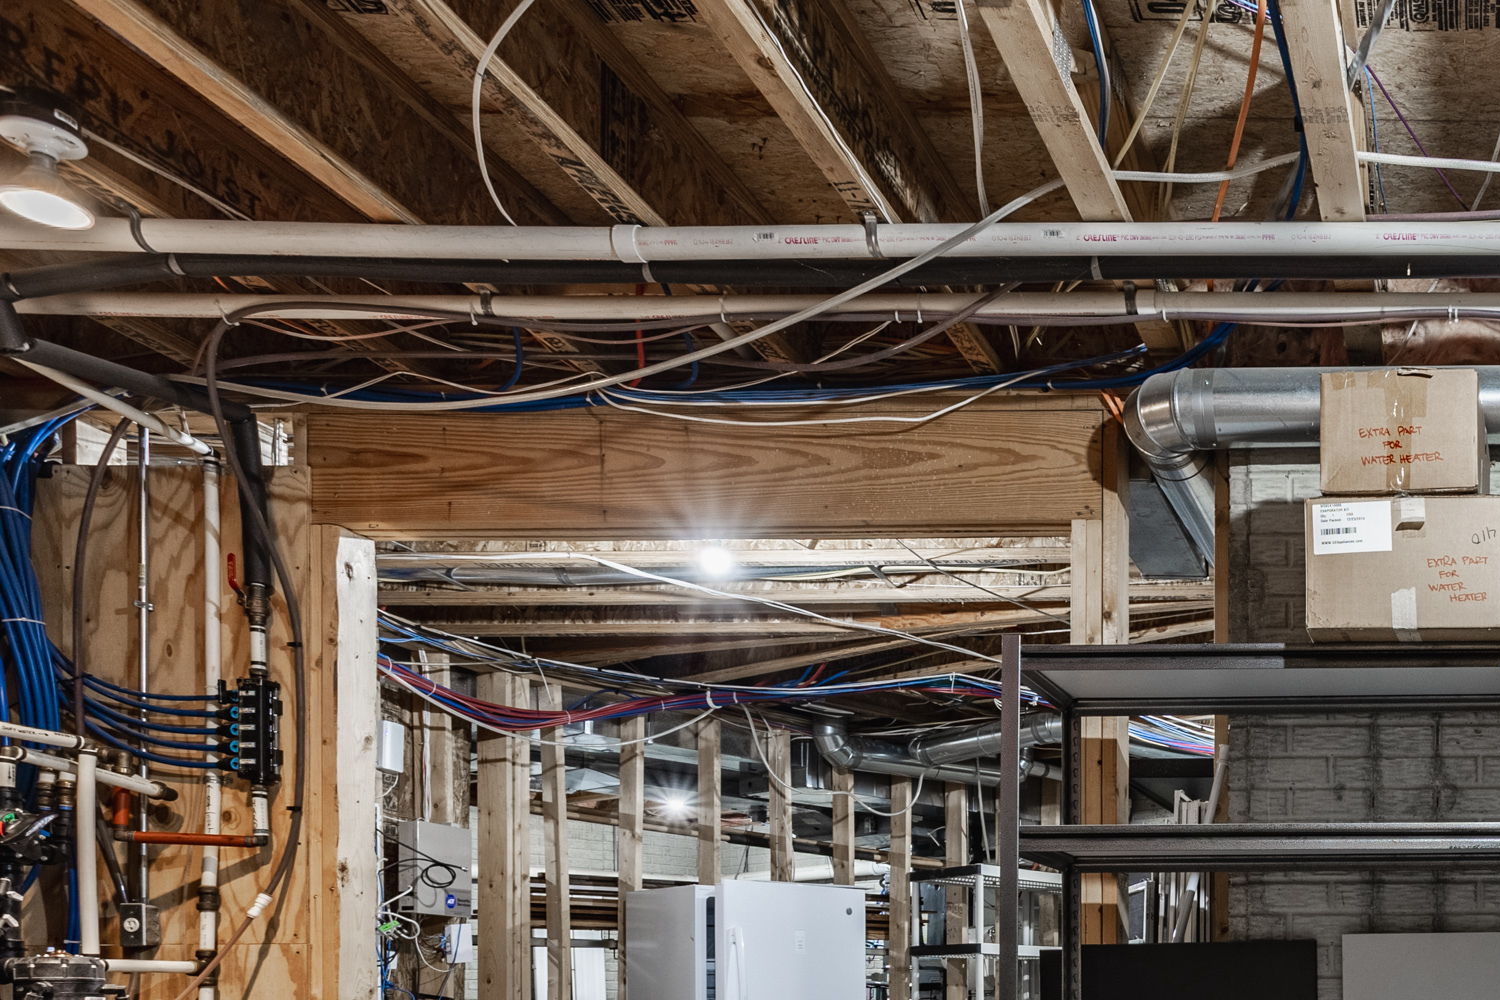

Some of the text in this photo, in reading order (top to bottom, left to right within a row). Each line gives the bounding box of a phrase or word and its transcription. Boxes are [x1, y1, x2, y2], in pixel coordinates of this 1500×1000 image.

[784, 236, 820, 244] CRESLINE
[1083, 234, 1118, 242] CRESLINE
[1382, 233, 1418, 241] CRESLINE
[1358, 426, 1422, 439] EXTRA PART
[1360, 451, 1444, 466] WATER HEATER
[1427, 555, 1488, 568] EXTRA PART
[1438, 569, 1460, 578] FOR
[1428, 581, 1467, 592] WATER
[1449, 592, 1487, 602] HEATER
